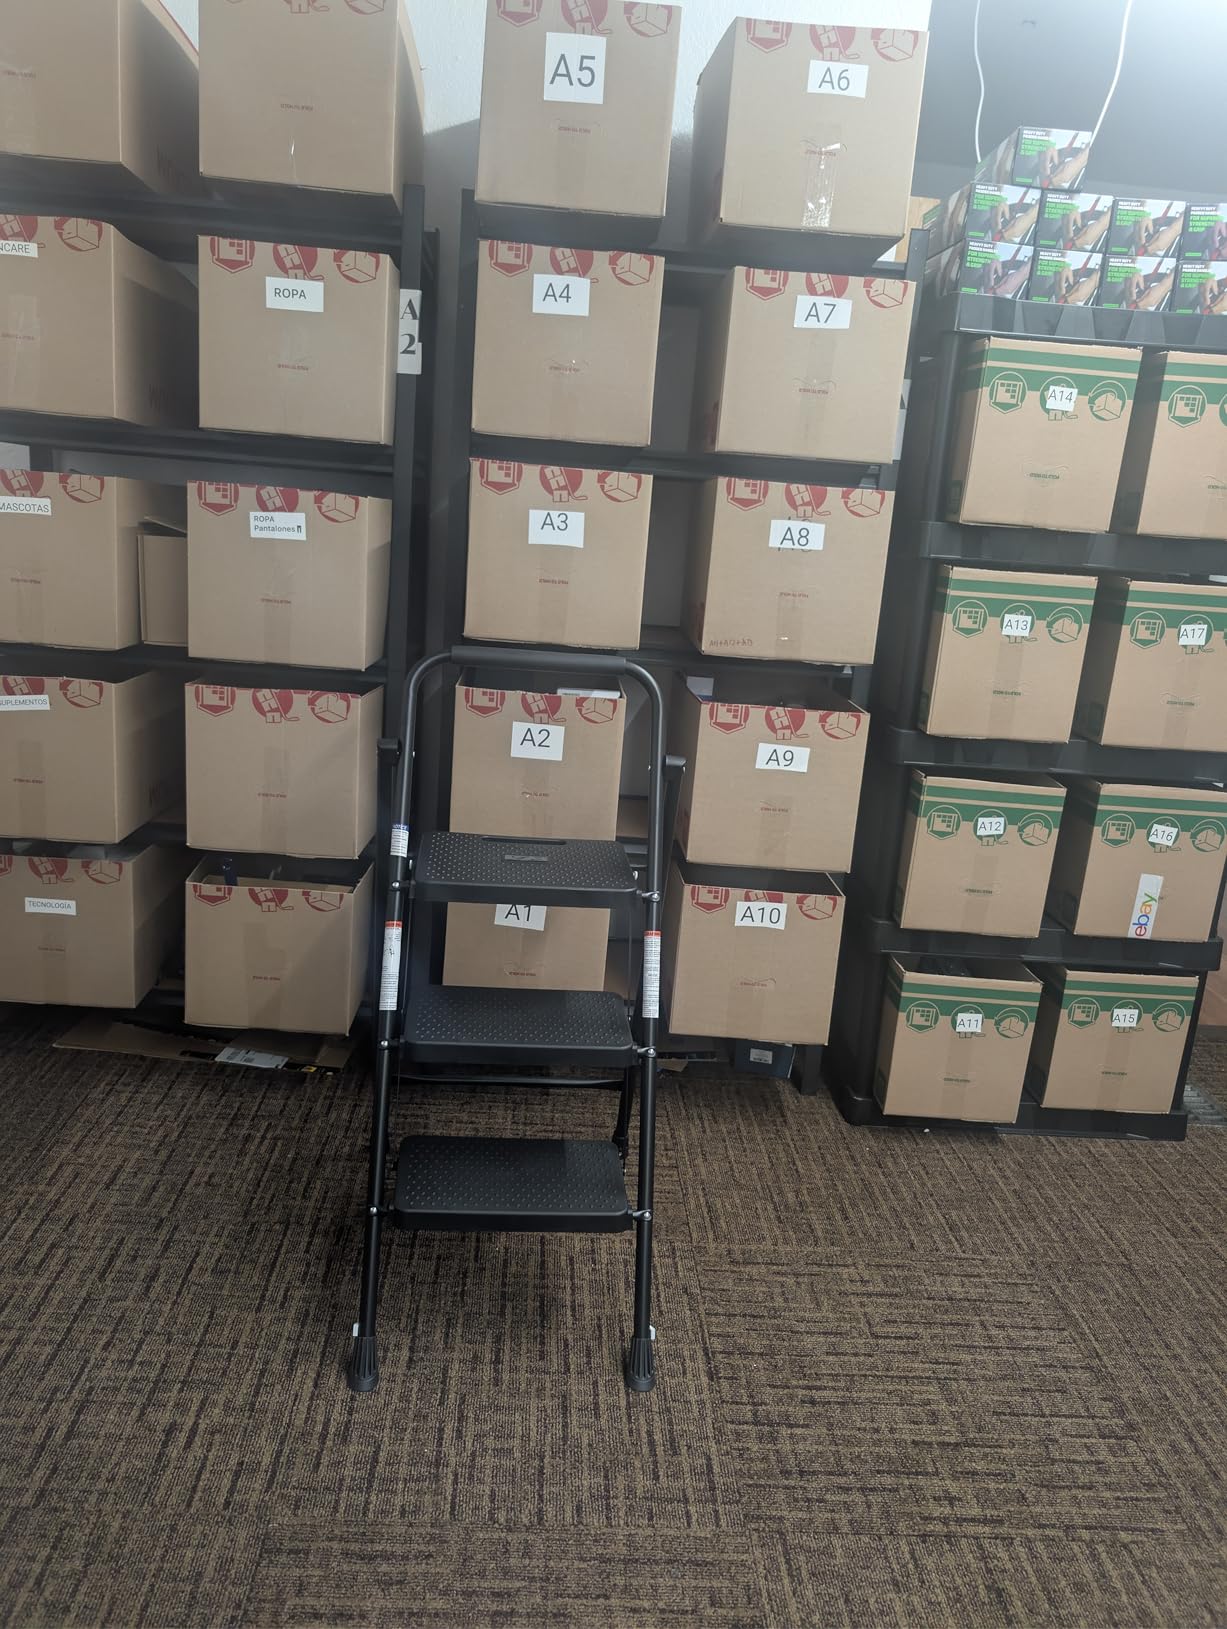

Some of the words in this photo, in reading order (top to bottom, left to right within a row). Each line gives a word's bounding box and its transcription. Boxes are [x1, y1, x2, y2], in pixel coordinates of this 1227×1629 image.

[550, 54, 596, 87] A5
[818, 66, 849, 91] A6
[274, 287, 307, 300] ROPA
[543, 282, 572, 304] A4
[805, 301, 837, 324] A7
[1048, 388, 1073, 403] A14
[253, 515, 275, 523] ROPA
[541, 512, 569, 531] A3
[254, 524, 296, 533] Pantalones
[780, 526, 810, 547] A8
[1004, 618, 1028, 631] A13
[1179, 627, 1205, 639] A17
[520, 728, 551, 748] A2
[766, 748, 794, 767] A9
[978, 821, 1002, 832] A12
[1149, 828, 1174, 842] A16
[505, 904, 531, 922] A1
[741, 905, 781, 925] A10
[1132, 893, 1157, 937] ebay
[957, 1018, 979, 1029] A11
[1111, 1012, 1135, 1024] A15
